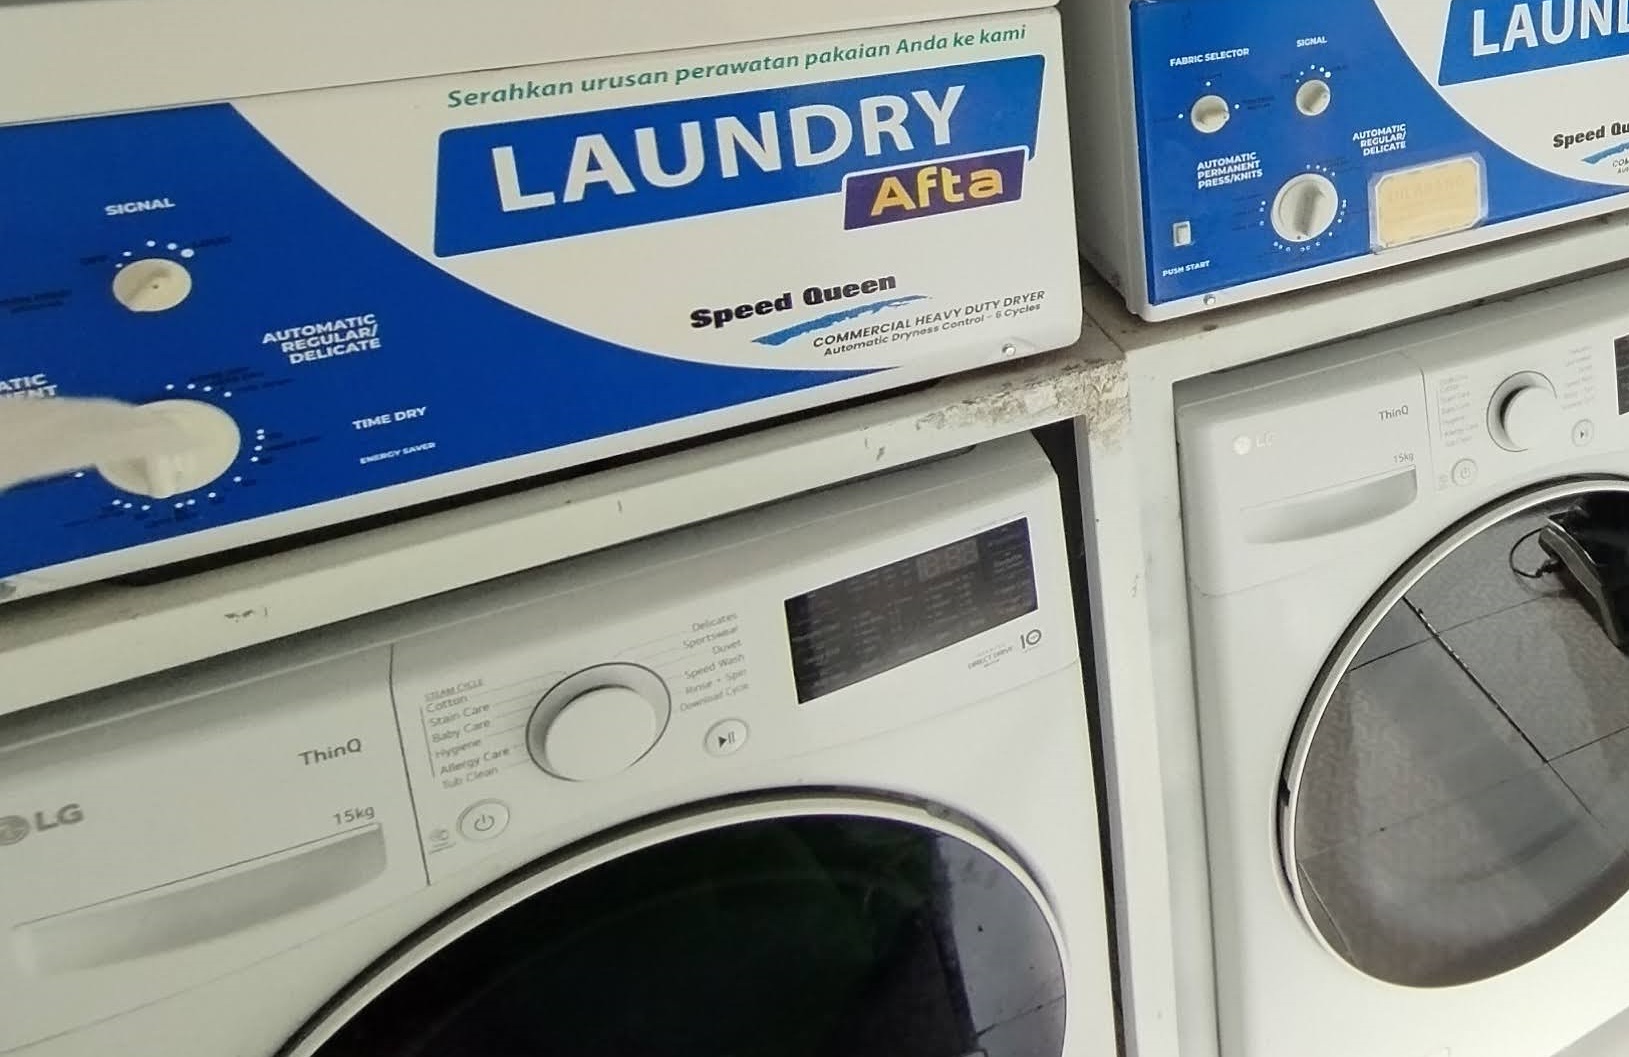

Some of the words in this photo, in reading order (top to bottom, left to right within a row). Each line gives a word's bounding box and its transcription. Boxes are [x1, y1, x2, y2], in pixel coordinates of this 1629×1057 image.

[1296, 35, 1327, 48] SIGNAL
[448, 79, 574, 109] Serahkan
[581, 70, 667, 91] urusan
[675, 55, 799, 85] perawatan
[804, 42, 891, 70] pakaian
[896, 32, 948, 55] Anda
[953, 32, 975, 47] ke
[980, 23, 1027, 44] kami
[1170, 53, 1203, 67] FABRIC
[1204, 47, 1250, 62] SELECTOR
[1352, 123, 1407, 142] AUTOMATIC
[1553, 125, 1606, 150] Speed
[492, 85, 966, 213] LAUNDRY
[1363, 140, 1407, 156] DELICATE
[1197, 151, 1257, 171] AUTOMATIC
[1197, 160, 1261, 180] PERMANENT
[870, 165, 1004, 217] Afta
[1197, 168, 1263, 190] PRESS/KNITS
[104, 198, 176, 216] SIGNAL
[1162, 265, 1185, 277] PUSH
[1185, 259, 1210, 272] START
[690, 291, 793, 330] Speed
[802, 275, 896, 307] Queen
[262, 313, 376, 344] AUTOMATIC
[813, 319, 912, 348] COMMERCIAL
[915, 308, 962, 327] HEAVY
[964, 299, 1001, 316] DUTY
[1003, 290, 1045, 307] DRYER
[824, 335, 888, 357] Automatic
[892, 325, 940, 343] Dryness
[942, 314, 985, 331] Control
[1004, 303, 1041, 318] Cycles
[281, 324, 378, 353] REGULAR/
[289, 337, 382, 365] DELICATE
[0, 373, 48, 391] ATIC
[352, 413, 392, 430] TIME
[394, 406, 427, 423] DRY
[1377, 404, 1409, 421] ThinQ
[359, 448, 401, 465] ENERGY
[402, 441, 436, 456] SAVER
[1393, 452, 1414, 464] 15kg
[692, 612, 738, 632] Delicates
[684, 662, 716, 680] Speed
[718, 654, 745, 668] Wash
[426, 694, 468, 713] Cotton
[430, 711, 461, 727] Stain
[463, 702, 490, 717] Care
[432, 728, 460, 744] Baby
[463, 719, 491, 733] Care
[297, 737, 363, 766] ThinQ
[440, 755, 481, 776] Allergy
[483, 747, 510, 762] Care
[442, 775, 463, 790] Tub
[466, 766, 499, 784] Clean
[35, 803, 84, 833] LG
[333, 804, 375, 826] 15kg
